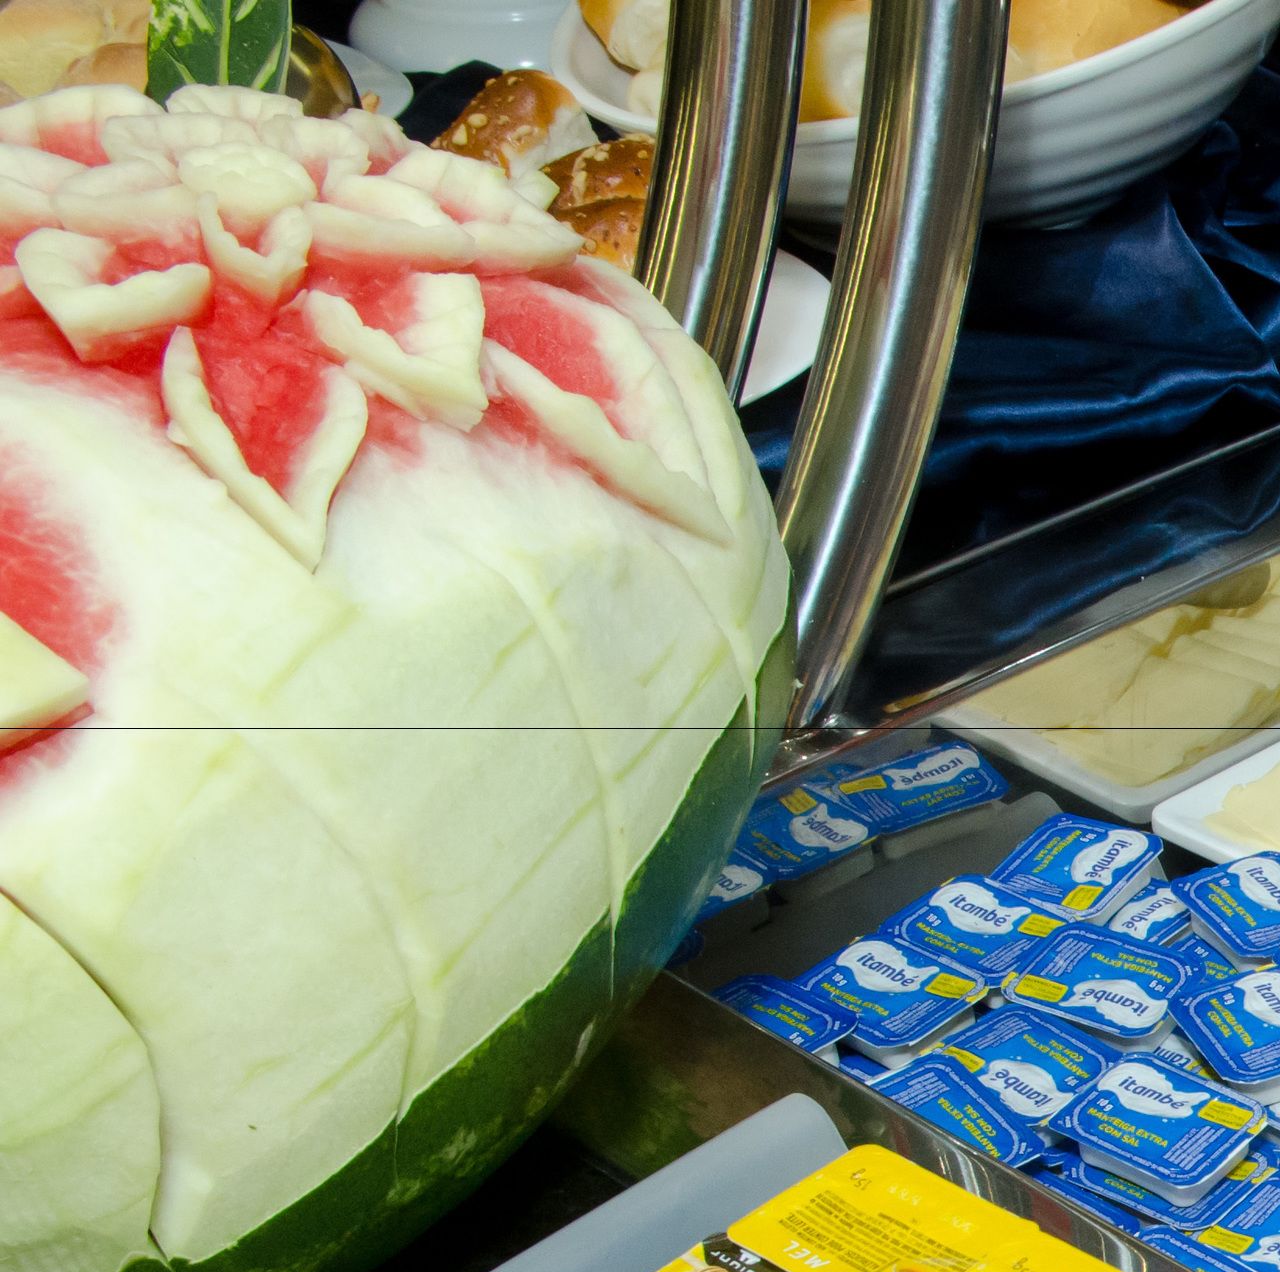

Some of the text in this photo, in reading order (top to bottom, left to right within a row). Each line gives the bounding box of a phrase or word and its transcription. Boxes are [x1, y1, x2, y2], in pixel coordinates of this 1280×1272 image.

[1085, 839, 1132, 879] itambé
[949, 894, 1011, 927] itambé
[857, 953, 916, 987] itambé
[1083, 987, 1149, 1017] itambé
[994, 1069, 1052, 1106] itambé
[1118, 1076, 1186, 1110] itambé
[1088, 1107, 1168, 1147] MANTEIGA EXTRA
[1099, 1122, 1140, 1147] COM SAL
[783, 1240, 830, 1269] MEL
